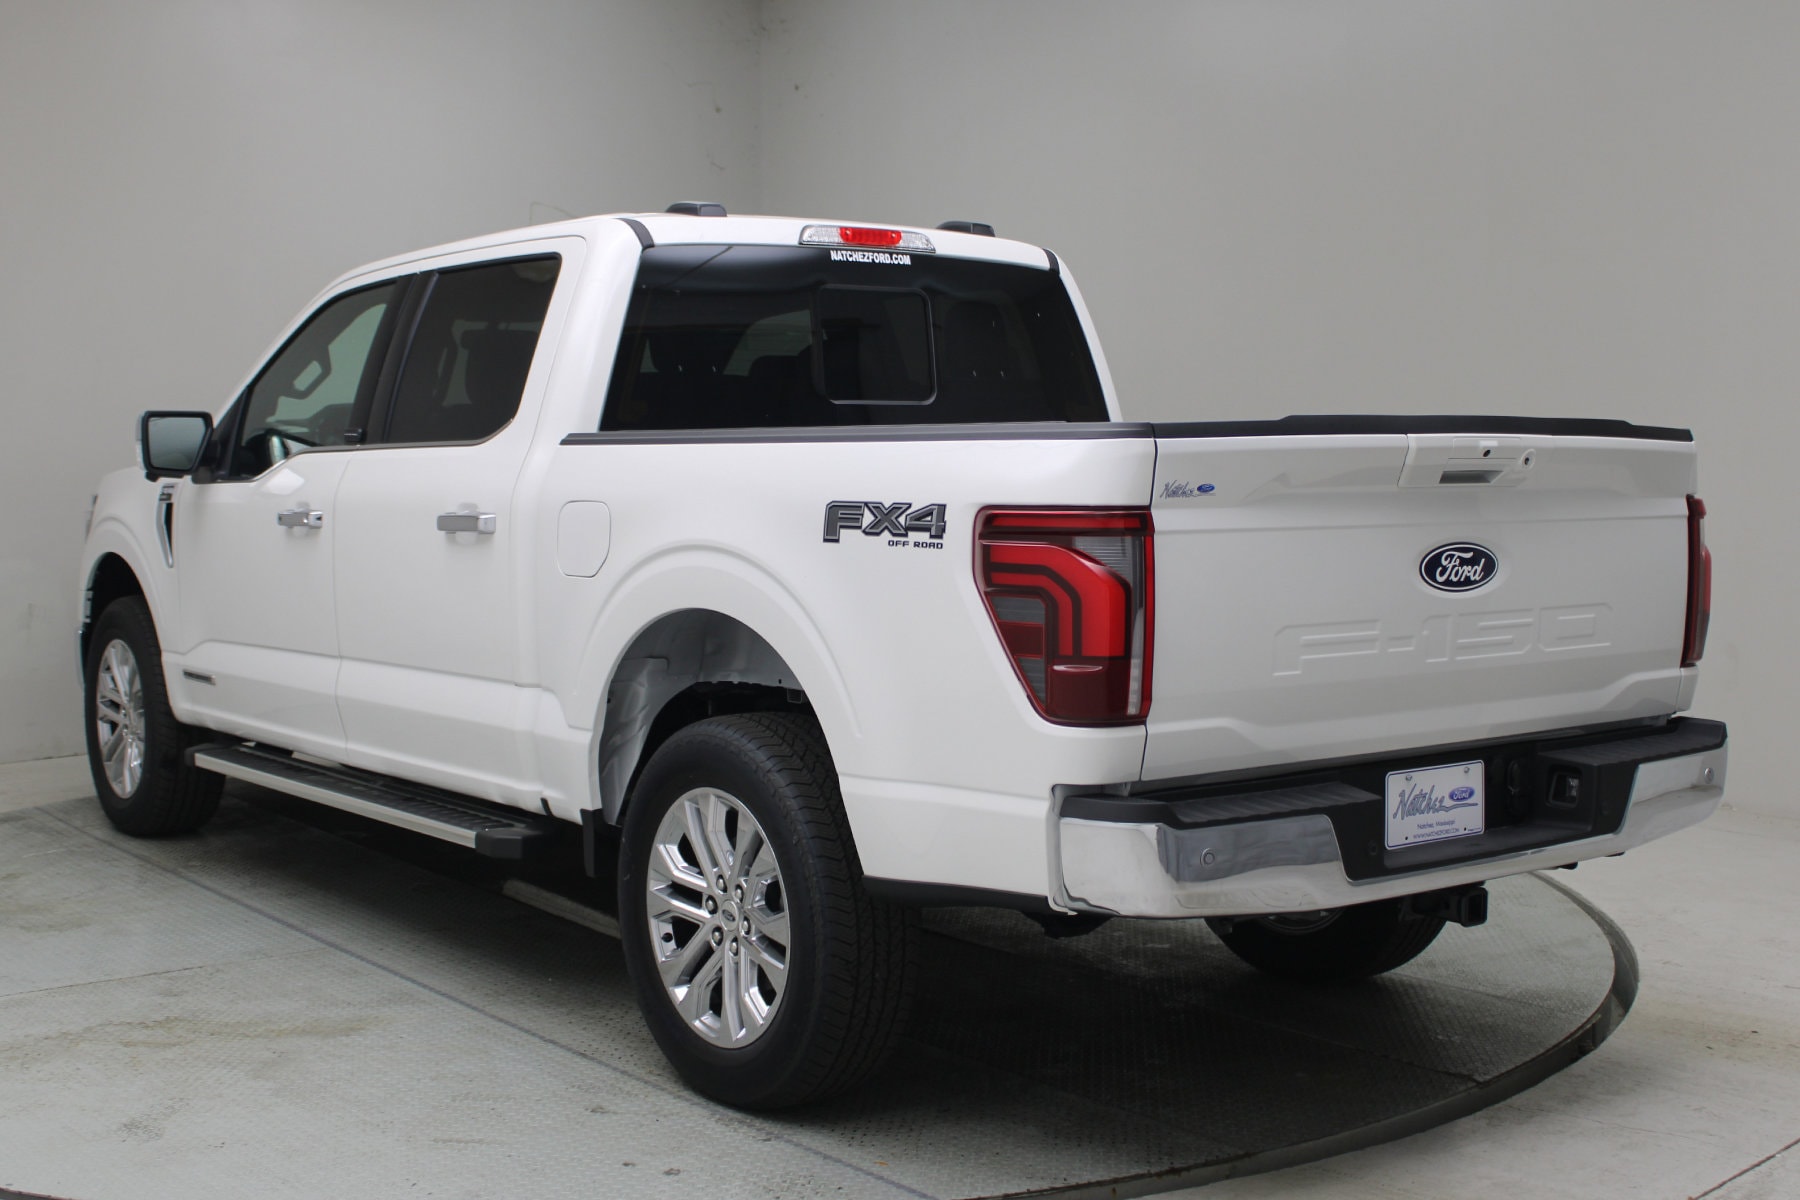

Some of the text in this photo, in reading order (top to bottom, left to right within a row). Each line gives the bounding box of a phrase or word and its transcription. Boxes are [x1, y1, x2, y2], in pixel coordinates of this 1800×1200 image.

[830, 250, 911, 265] NATCHEZFORD.COM
[823, 500, 947, 543] FX4
[888, 540, 943, 549] OFF ROAD
[1435, 550, 1485, 583] Ford
[1272, 602, 1614, 677] F-150
